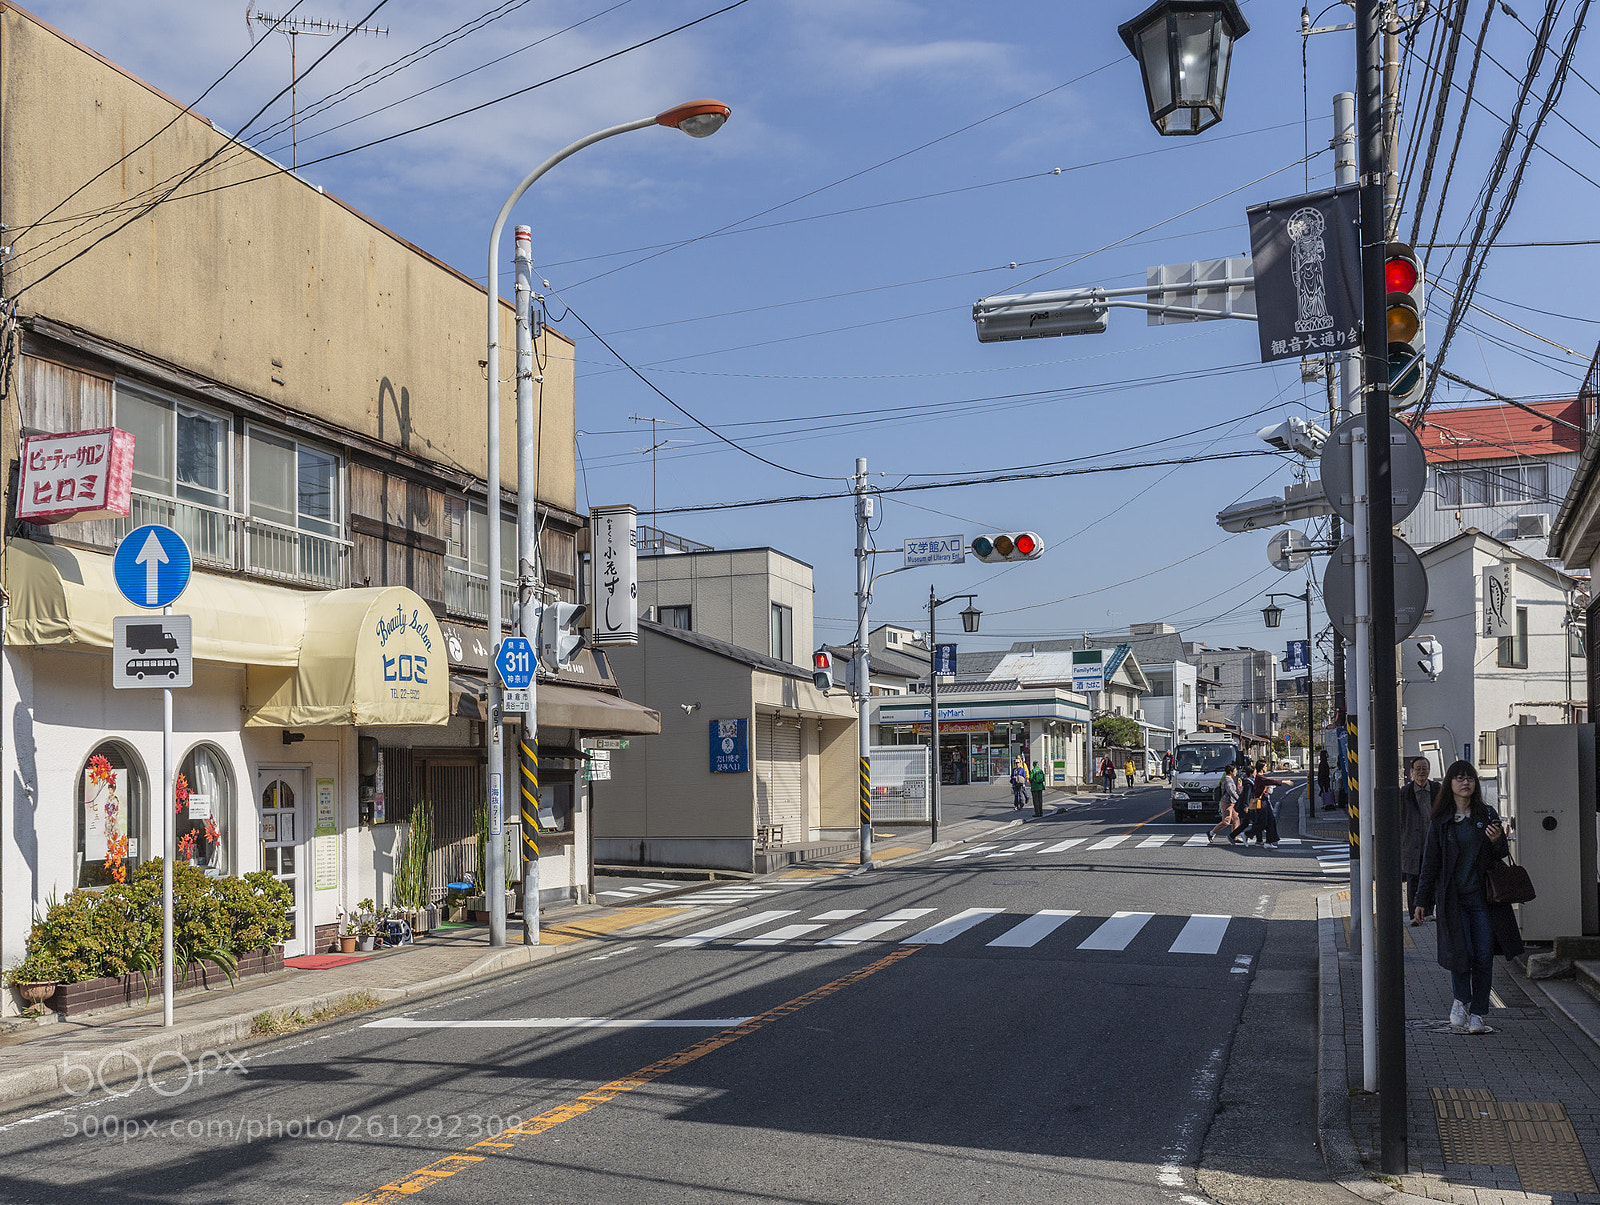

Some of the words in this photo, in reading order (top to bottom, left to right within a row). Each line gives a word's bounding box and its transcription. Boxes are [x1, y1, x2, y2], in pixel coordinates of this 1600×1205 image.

[1270, 326, 1358, 356] 観音大通り会
[33, 475, 98, 505] ヒロミ
[907, 539, 960, 555] 文学館入口
[907, 555, 927, 563] Museum
[927, 554, 933, 562] of
[933, 553, 951, 562] Literary
[376, 603, 408, 647] Beauty
[409, 609, 432, 654] Salon
[507, 641, 526, 650] 県道
[505, 651, 530, 672] 311
[382, 653, 428, 684] ヒロミ
[507, 674, 528, 683] 神奈川
[390, 688, 399, 699] TEL
[507, 692, 528, 701] 鎌倉市
[923, 709, 965, 718] FailyMart
